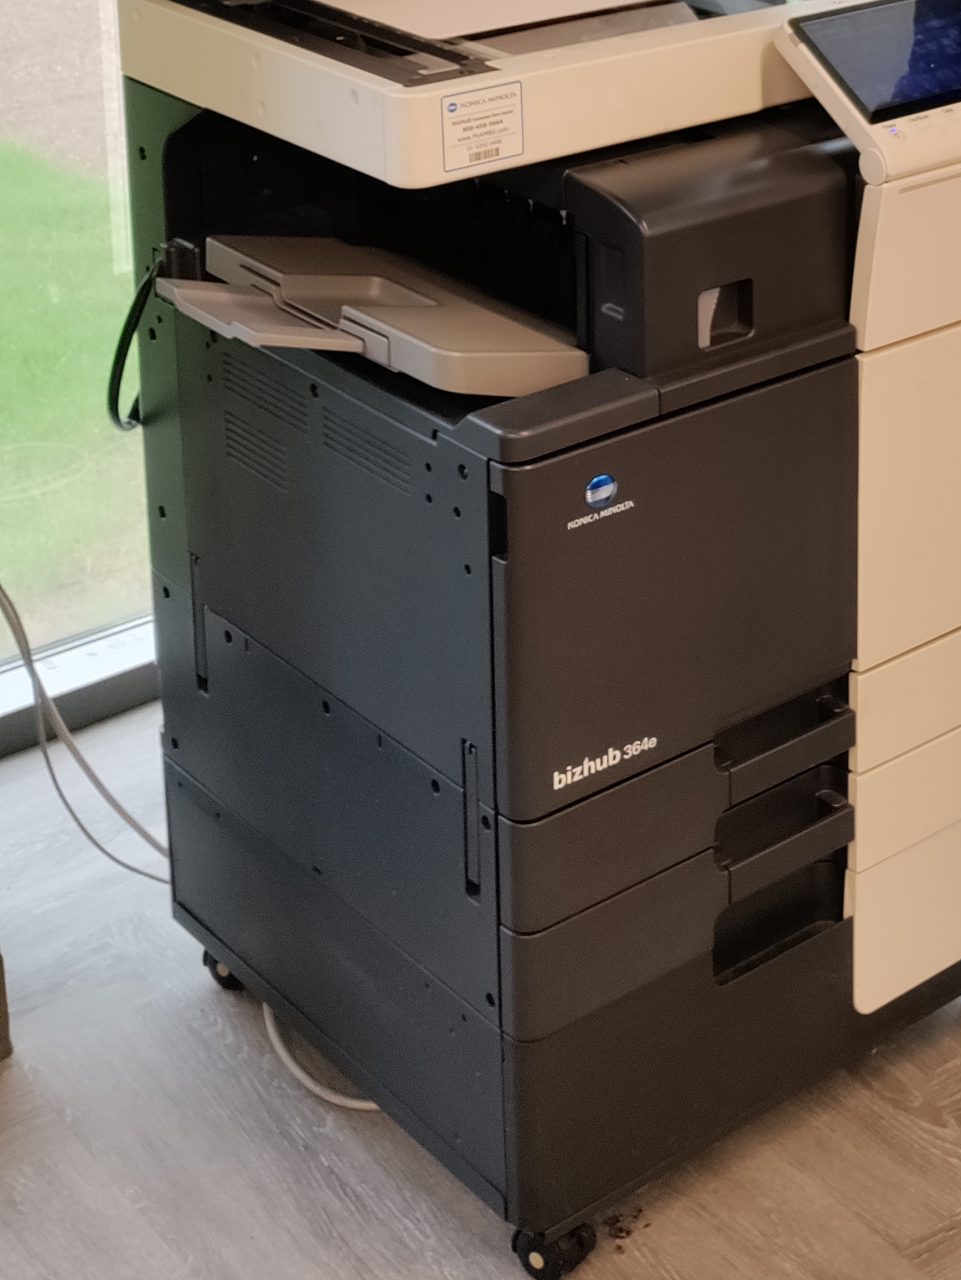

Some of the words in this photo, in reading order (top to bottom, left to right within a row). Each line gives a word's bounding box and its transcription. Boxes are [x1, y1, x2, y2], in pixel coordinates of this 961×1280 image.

[460, 99, 486, 109] KONICA
[488, 91, 517, 104] MINOLTA
[567, 513, 599, 530] KONICA
[600, 500, 634, 519] MINOLTA
[553, 747, 621, 791] bizhub
[623, 736, 658, 760] 364e
